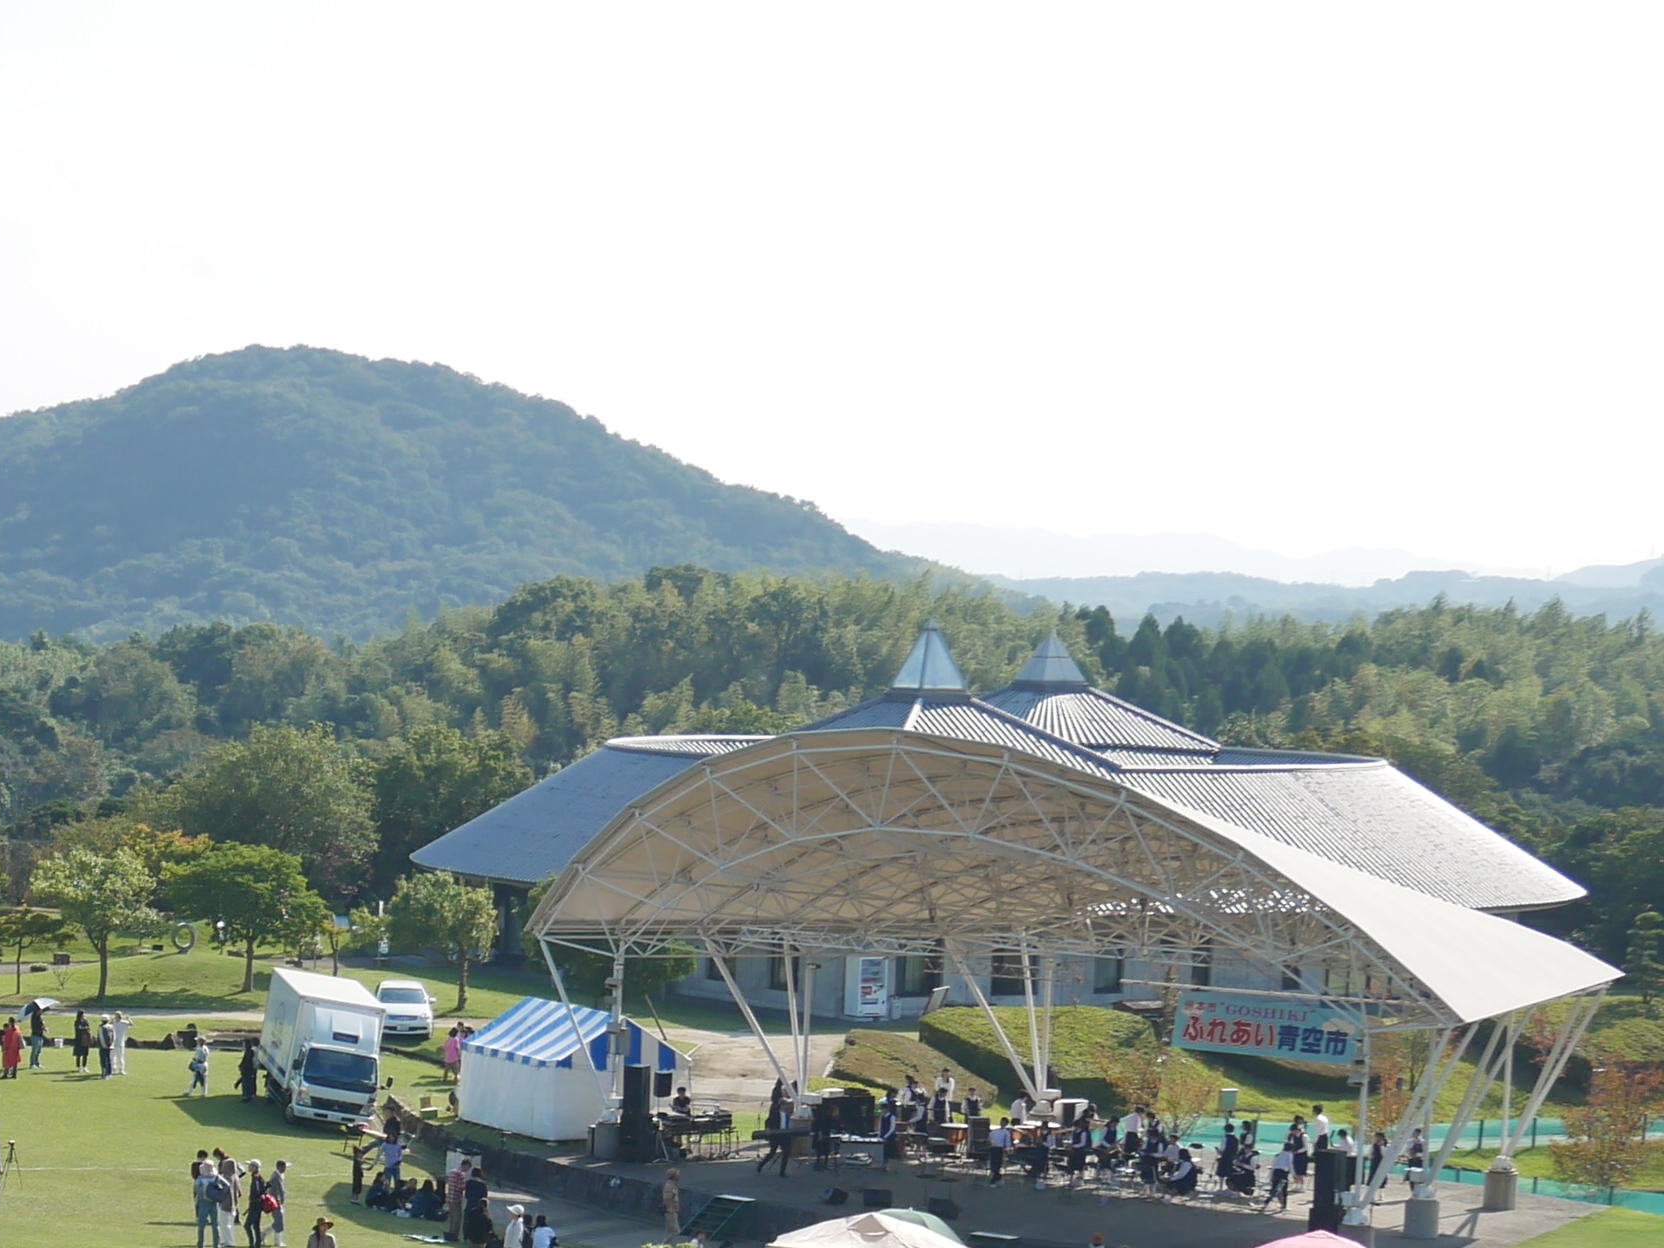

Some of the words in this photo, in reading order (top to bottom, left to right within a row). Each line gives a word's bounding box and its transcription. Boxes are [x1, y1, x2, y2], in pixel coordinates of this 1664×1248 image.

[1182, 1015, 1349, 1056] ふれあい青空市
